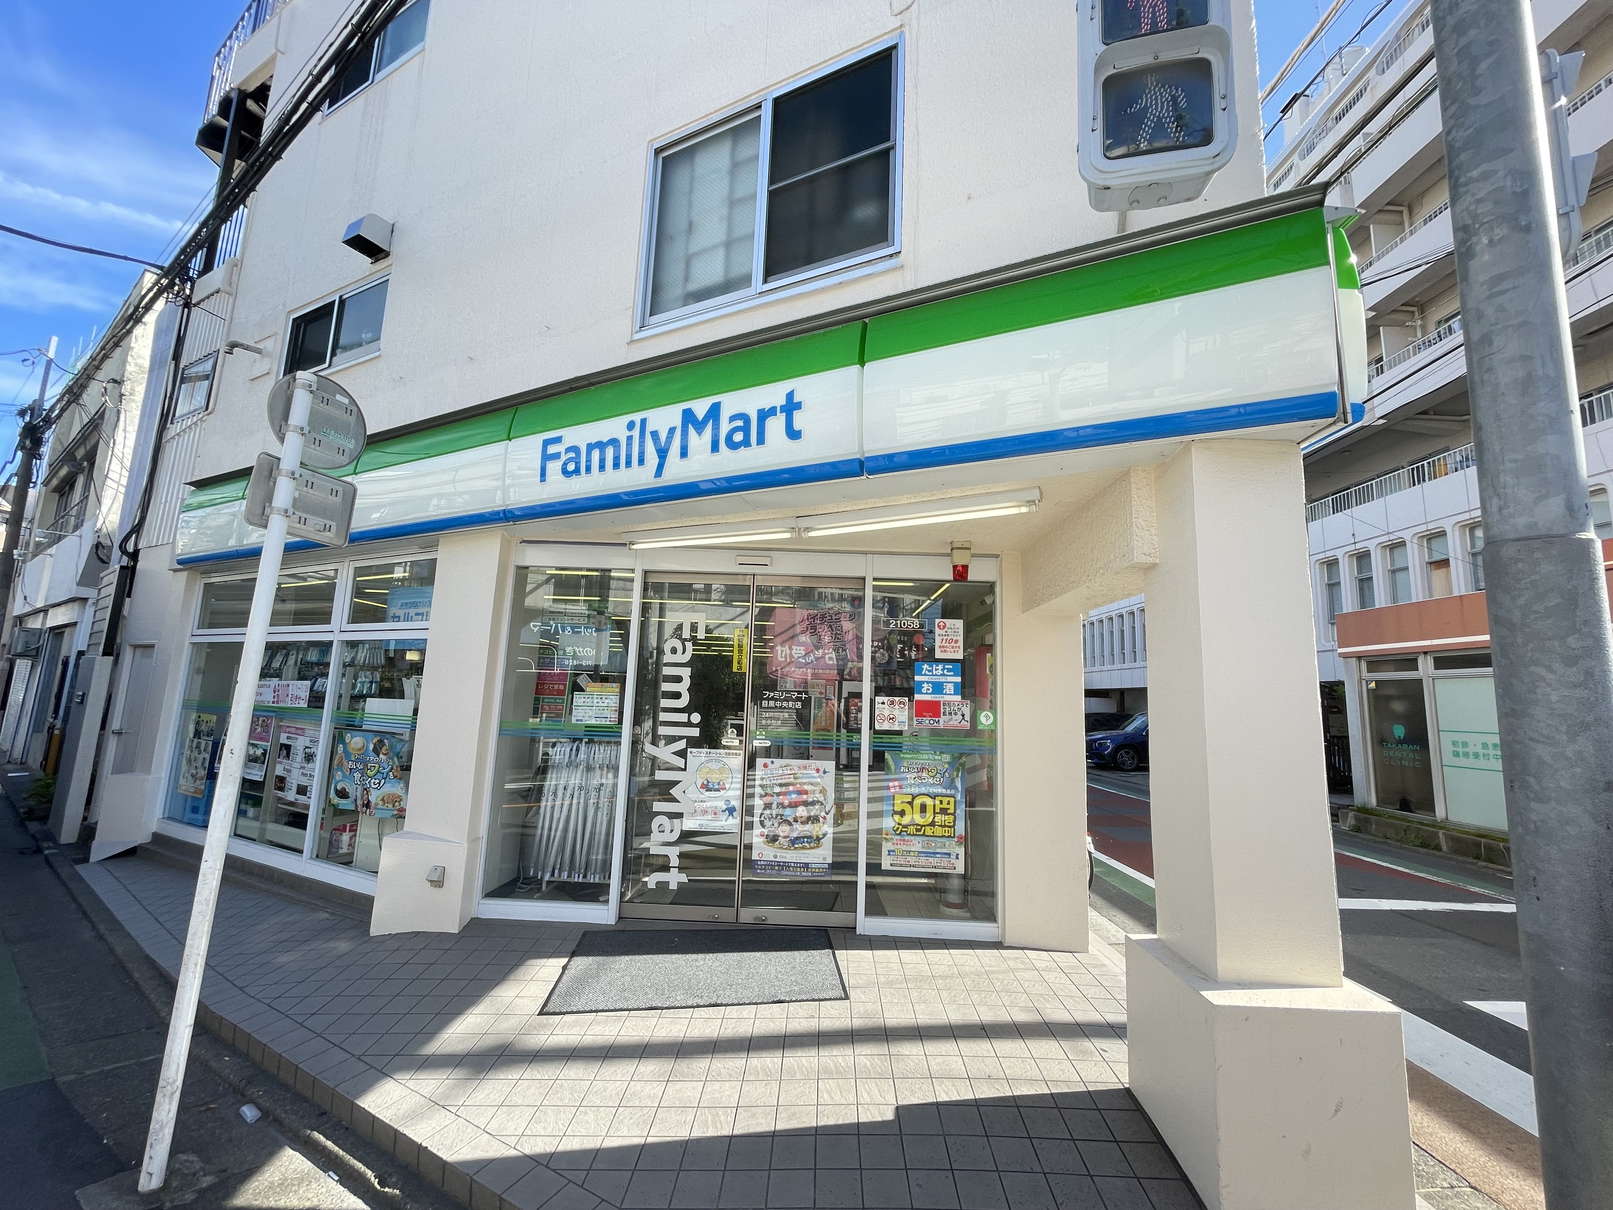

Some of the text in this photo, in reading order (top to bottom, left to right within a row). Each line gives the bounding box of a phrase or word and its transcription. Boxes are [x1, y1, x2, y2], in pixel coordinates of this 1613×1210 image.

[539, 388, 803, 483] FamilyMart
[889, 619, 920, 629] 21058
[921, 663, 954, 676] たばこ
[921, 681, 955, 695] お酒
[762, 690, 809, 700] ファミリーマート
[644, 611, 706, 890] FamilyMart
